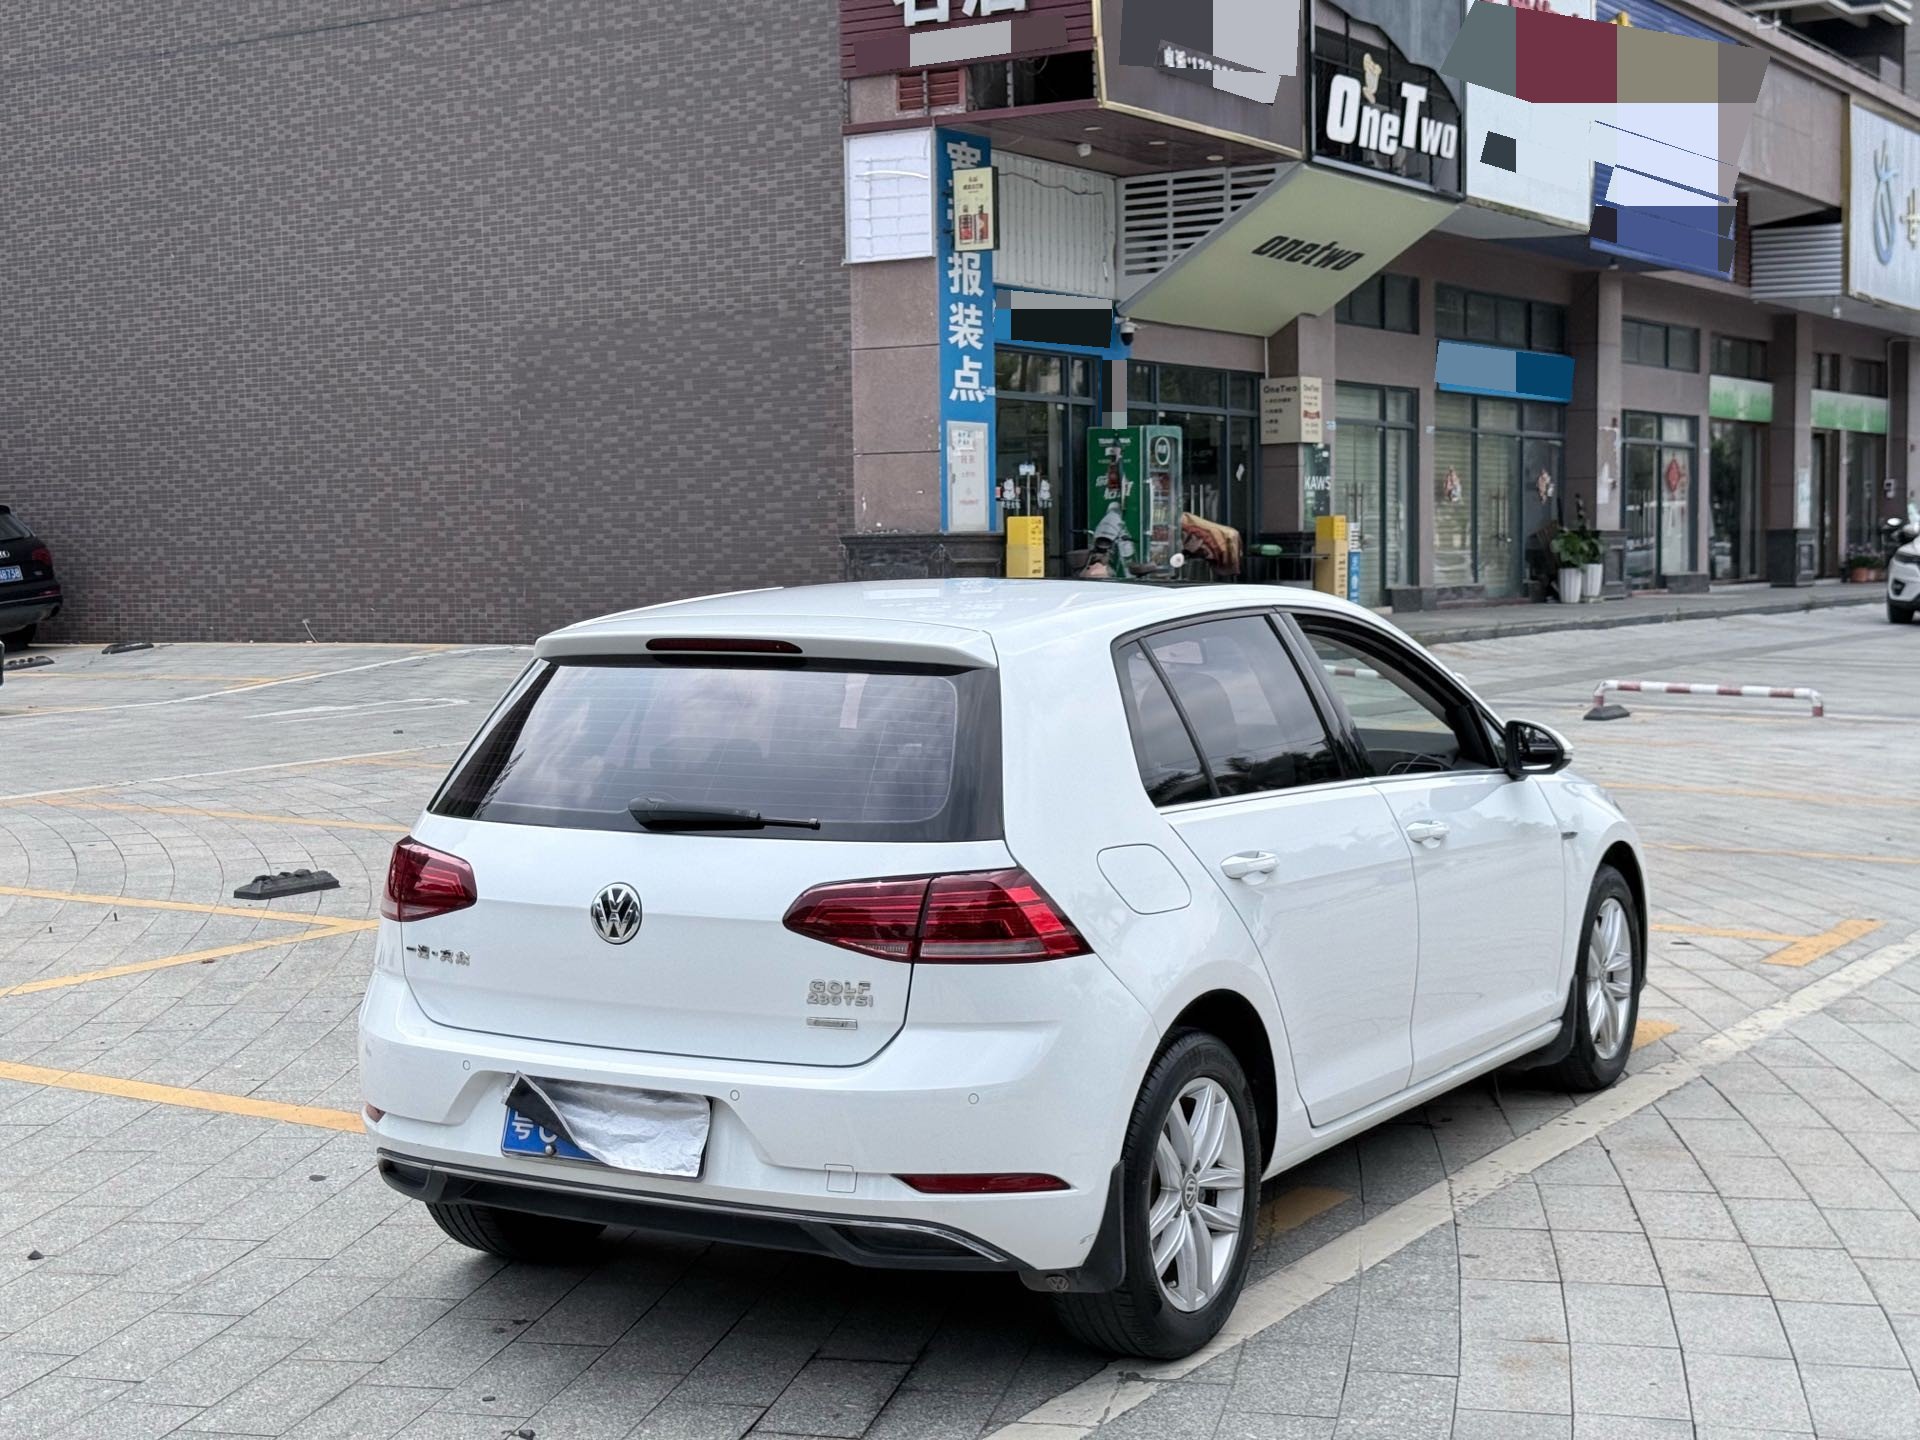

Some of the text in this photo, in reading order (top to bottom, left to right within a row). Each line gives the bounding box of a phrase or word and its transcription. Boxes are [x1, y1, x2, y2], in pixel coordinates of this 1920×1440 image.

[1326, 74, 1458, 160] OneTwo
[1251, 235, 1365, 271] onetwo
[947, 141, 984, 402] 宽报装点
[1304, 476, 1331, 491] KAWS
[809, 979, 872, 994] GOLF
